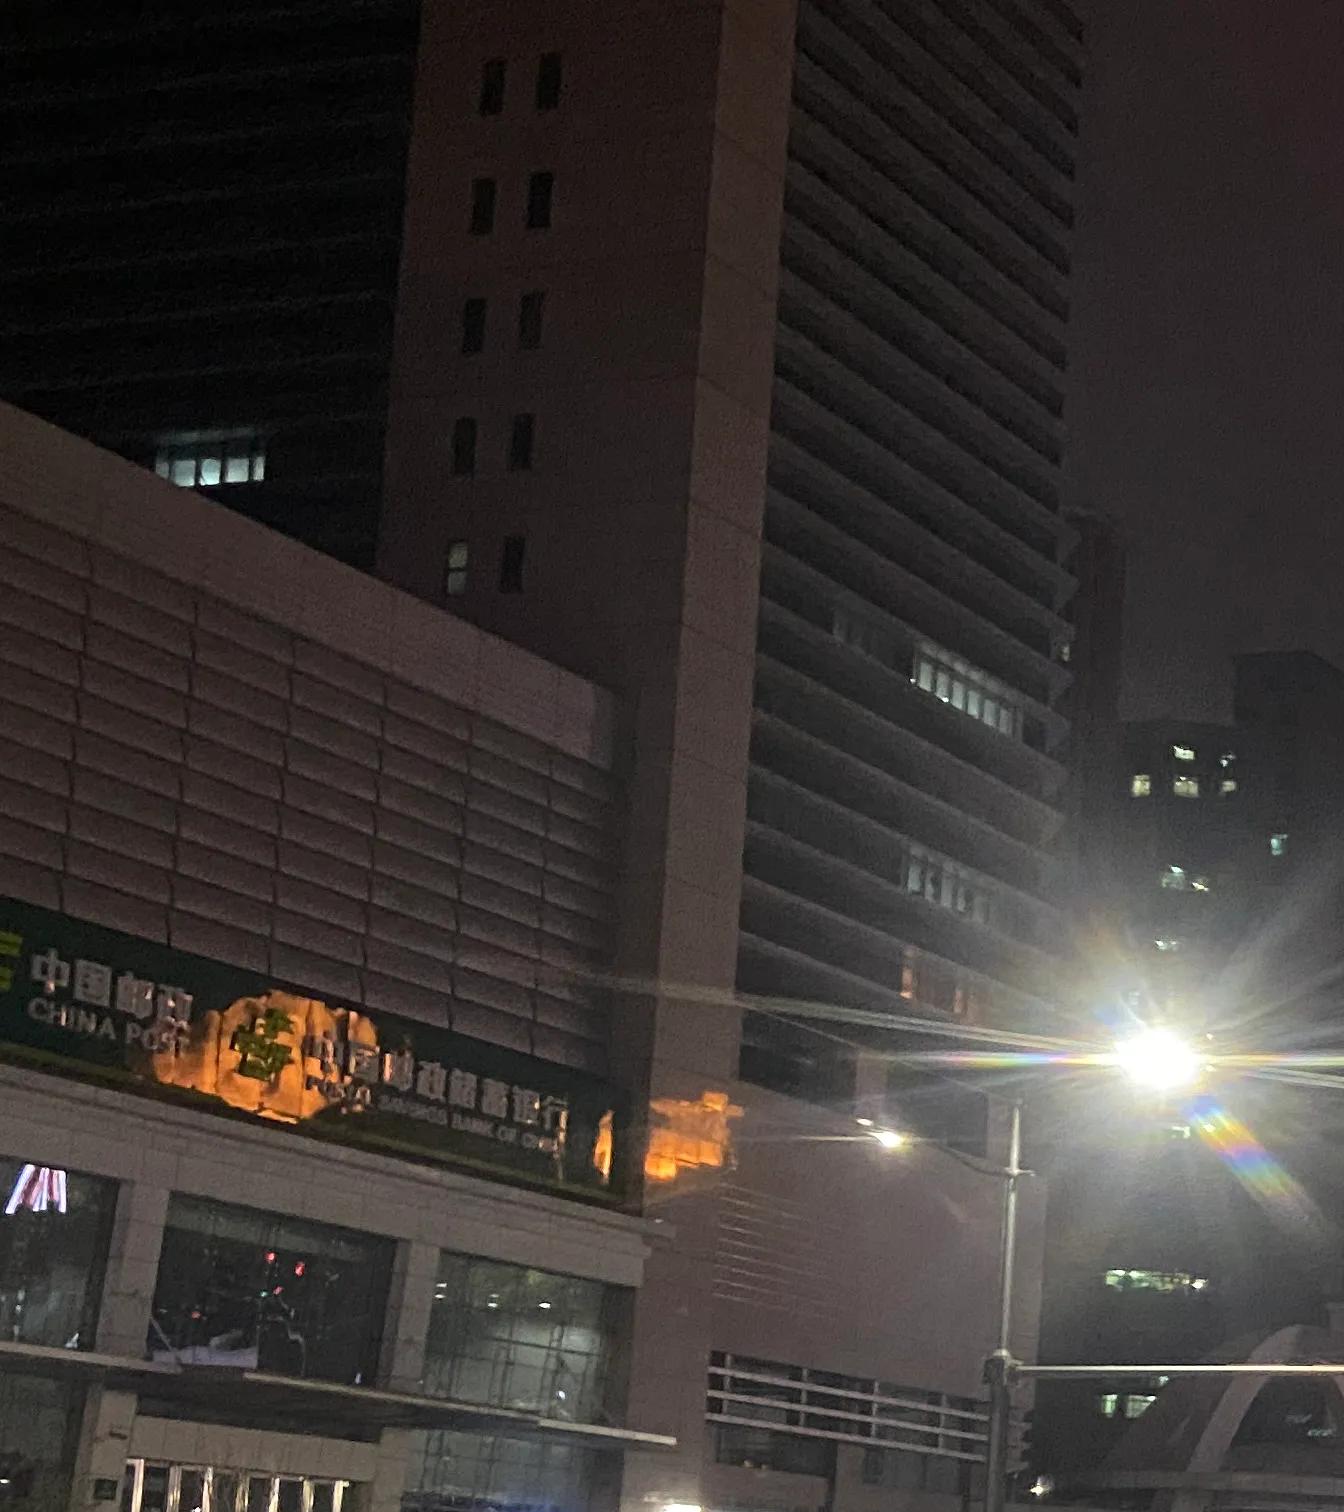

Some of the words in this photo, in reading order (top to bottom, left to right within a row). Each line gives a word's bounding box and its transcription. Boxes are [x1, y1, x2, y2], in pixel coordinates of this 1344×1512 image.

[31, 948, 194, 1021] 中国邮政
[28, 997, 117, 1041] CHINA
